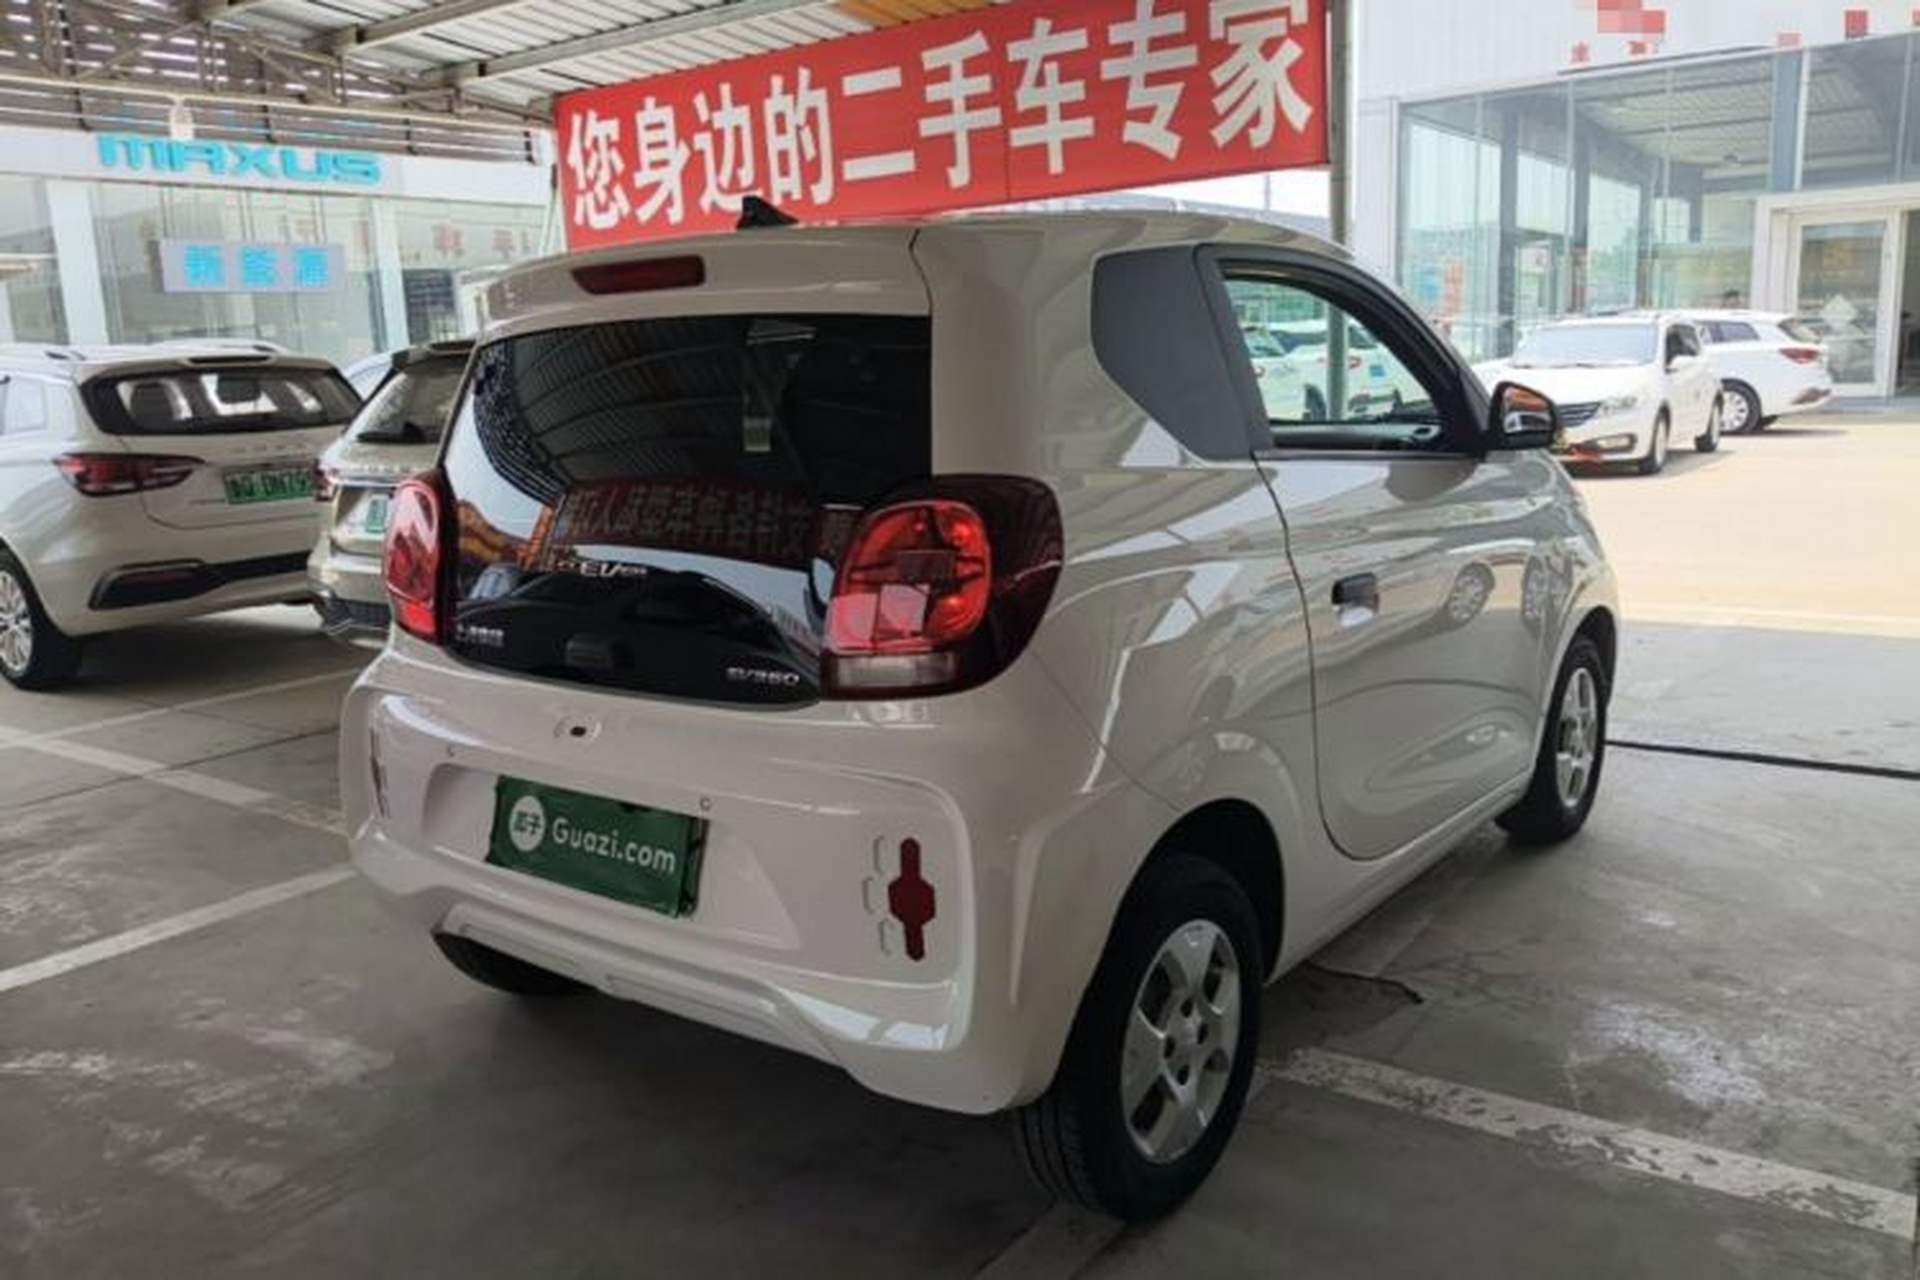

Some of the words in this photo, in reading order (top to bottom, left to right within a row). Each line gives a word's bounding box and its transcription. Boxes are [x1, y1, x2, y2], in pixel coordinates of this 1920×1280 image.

[98, 132, 382, 185] MAXUS
[567, 0, 1312, 229] 您身边的二手车专家
